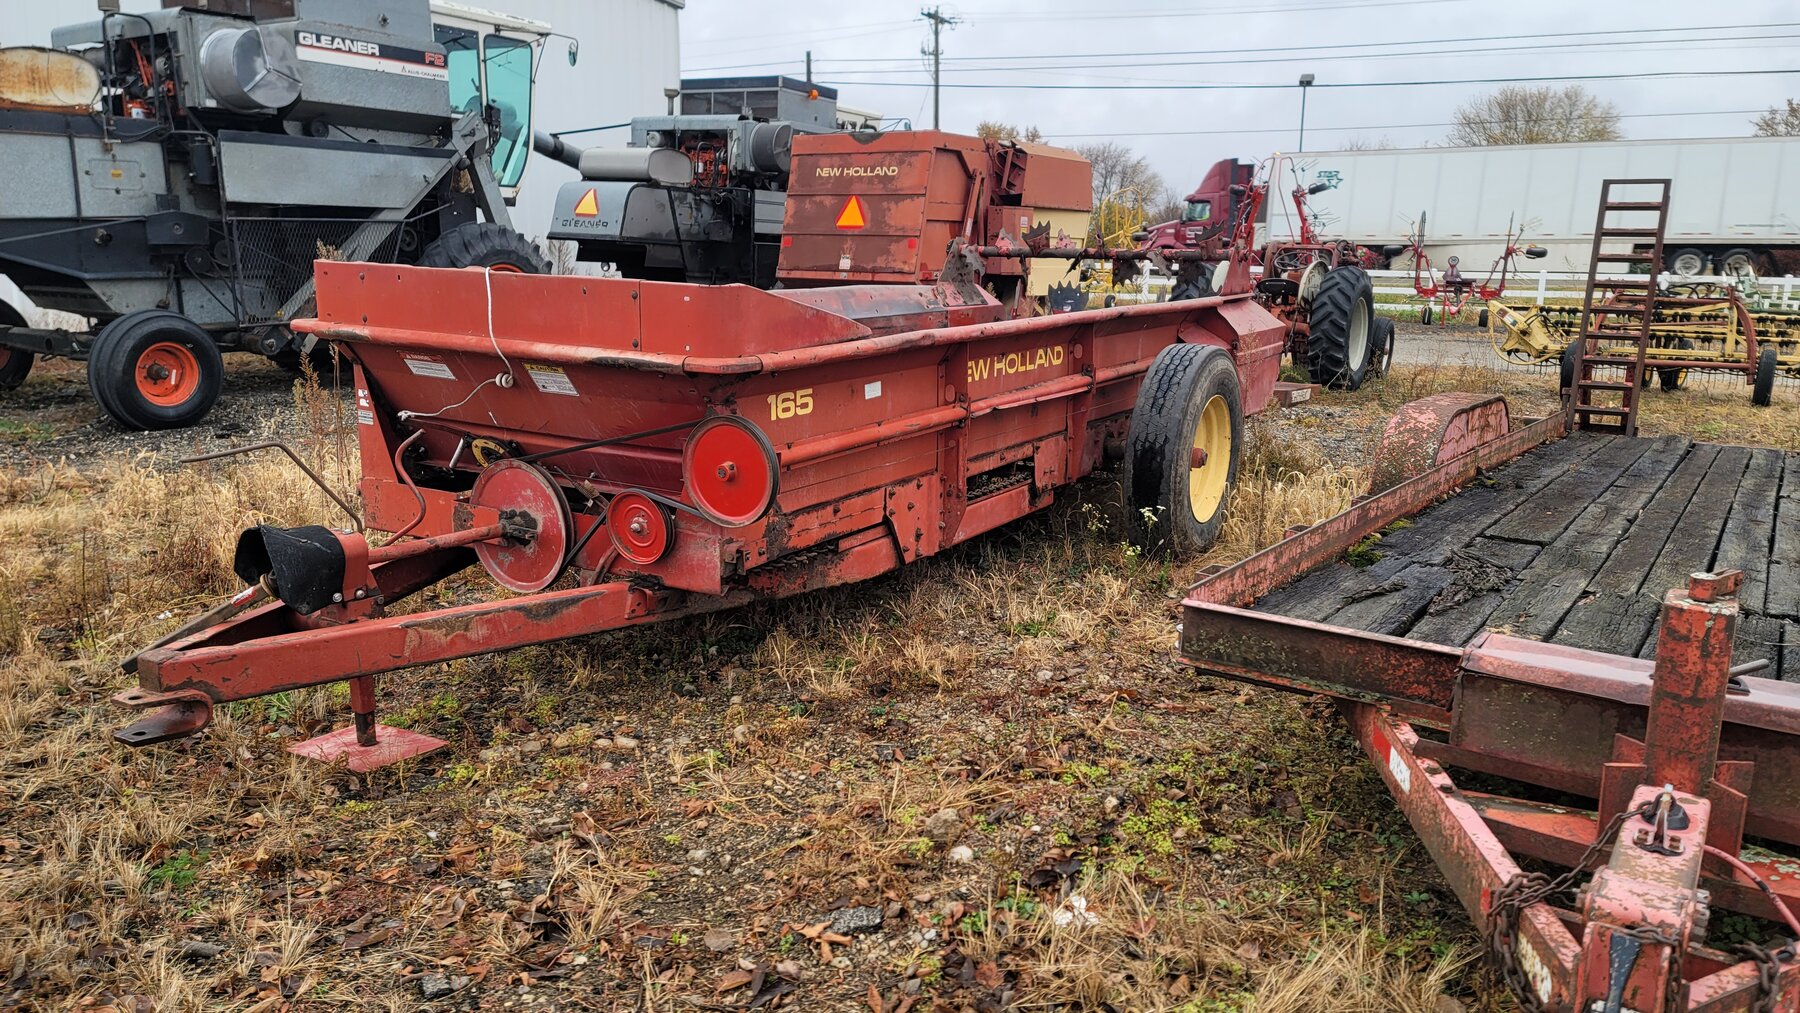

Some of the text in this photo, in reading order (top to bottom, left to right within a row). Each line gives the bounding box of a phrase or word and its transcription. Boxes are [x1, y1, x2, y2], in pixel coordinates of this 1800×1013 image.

[298, 31, 445, 66] GLEANER F2
[816, 166, 899, 177] NEW HOLLAND
[994, 345, 1064, 377] HOLLAND
[766, 388, 814, 421] 165
